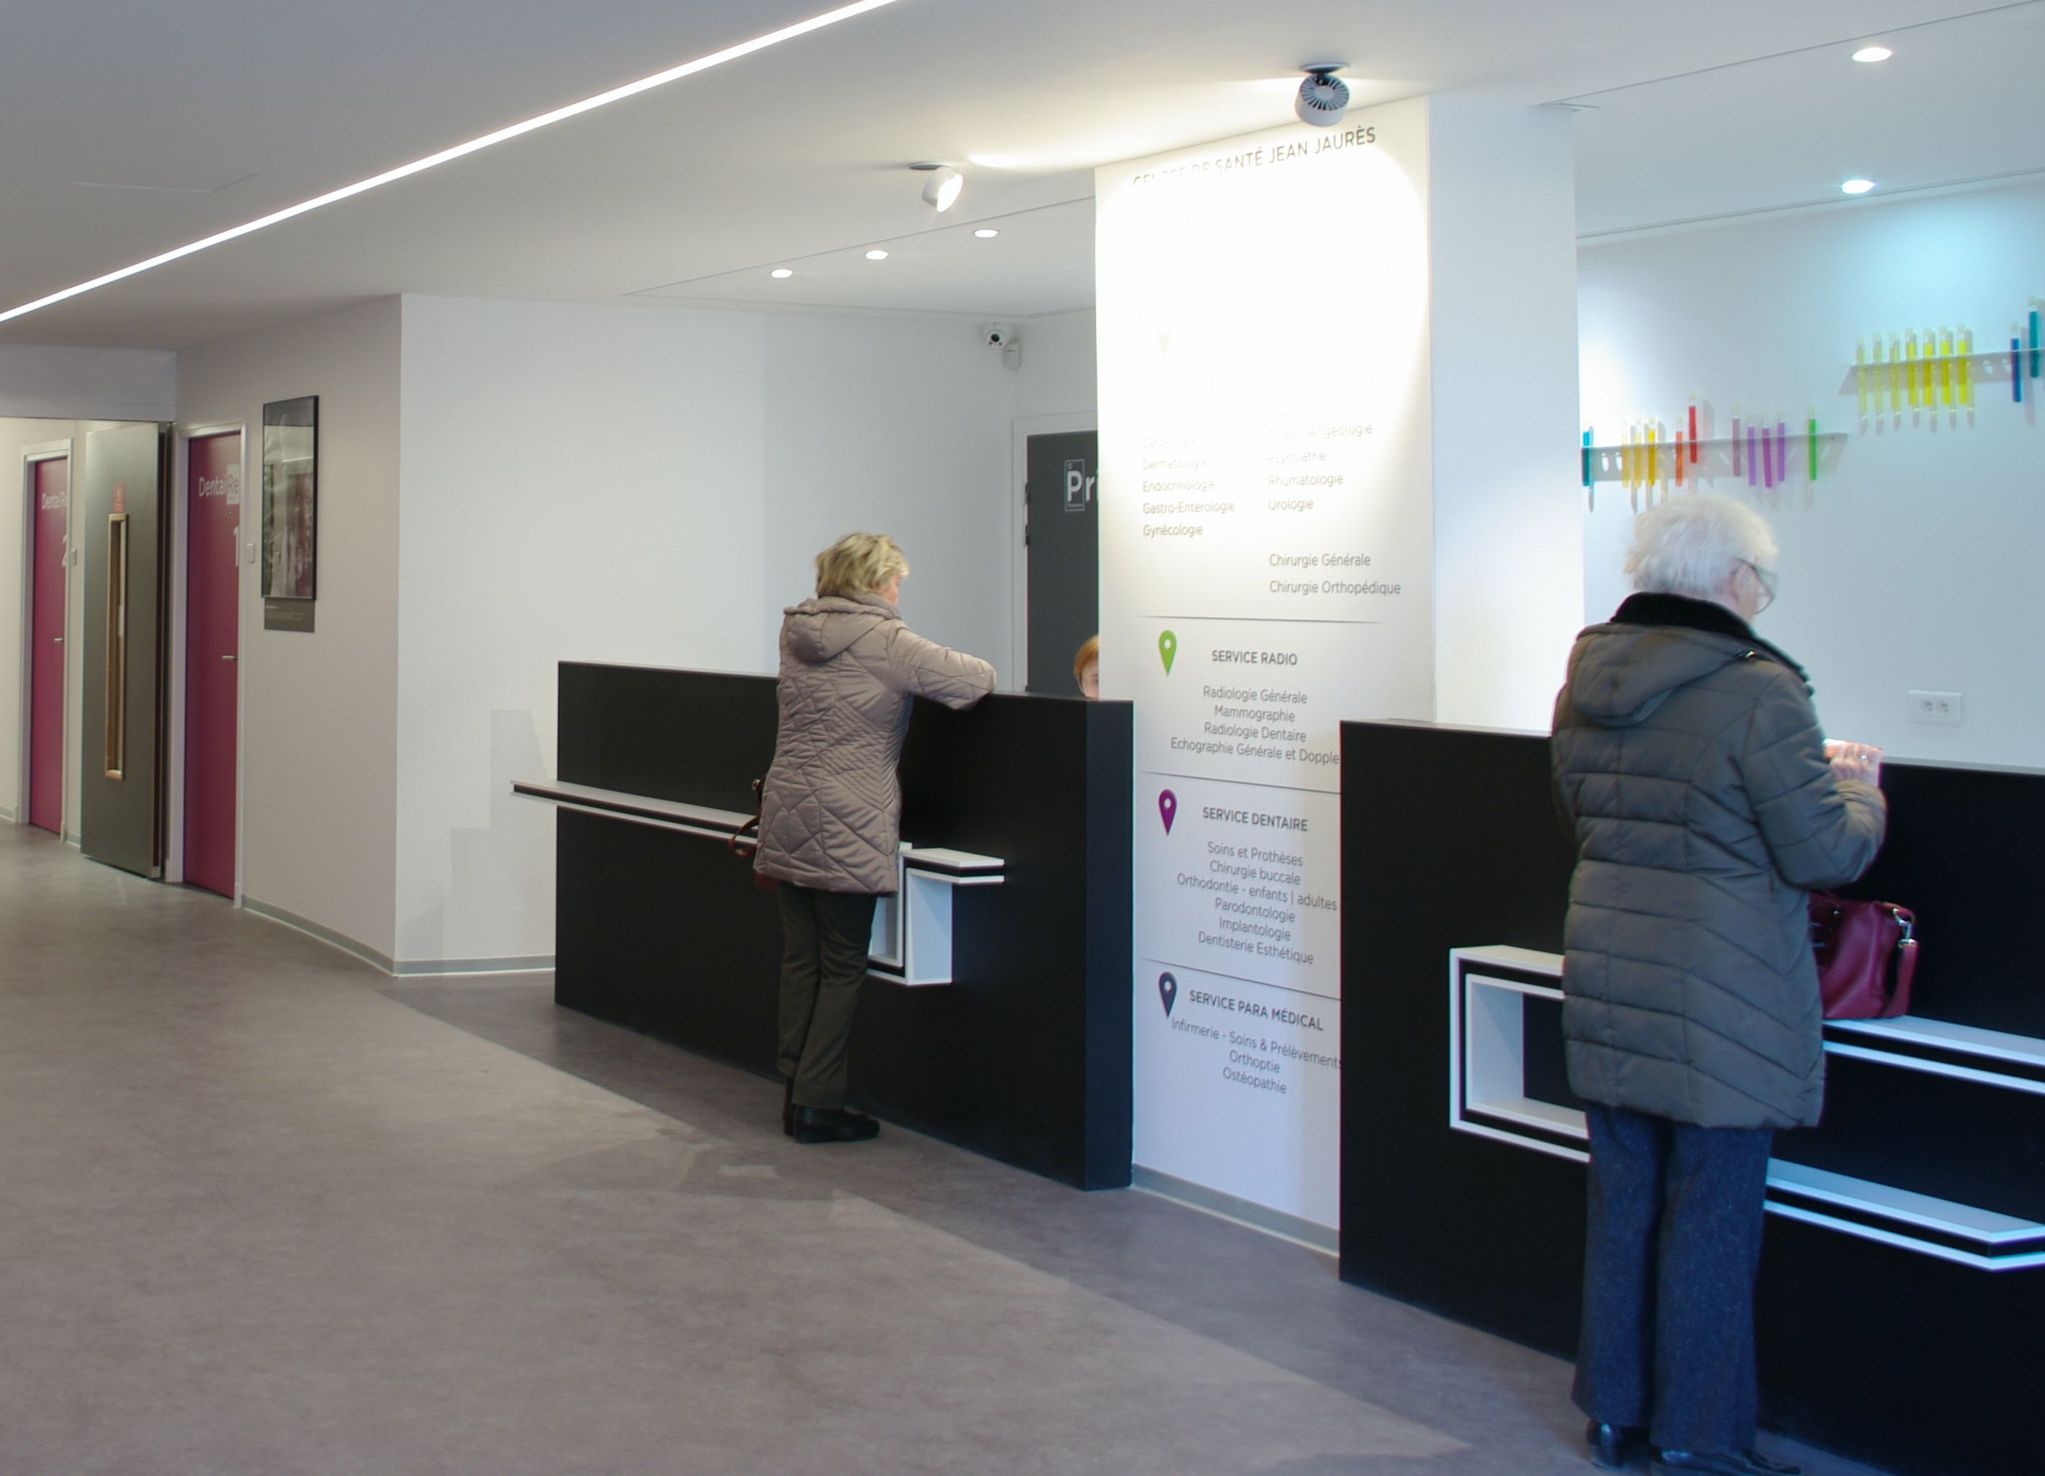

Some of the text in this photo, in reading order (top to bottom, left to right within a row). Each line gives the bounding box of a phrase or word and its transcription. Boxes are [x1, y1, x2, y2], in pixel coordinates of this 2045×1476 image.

[1215, 147, 1263, 173] SANTÉ
[1268, 140, 1308, 164] JEAN
[1314, 124, 1377, 154] JAURÈS
[1142, 480, 1216, 493] Endocrinologie
[1267, 474, 1345, 489] Rhumatologie
[1268, 498, 1315, 512] Urologie
[1142, 523, 1204, 538] Gynécologie
[1268, 552, 1372, 569] Chirurgie Générale
[1268, 580, 1402, 597] Chirurgie Orthopédique
[1211, 650, 1298, 666] SERVICE RADIO
[1203, 685, 1308, 704] Radiologie Générale
[1214, 704, 1296, 723] Mammographie
[1204, 721, 1307, 742] Radiologie Dentaire
[1170, 737, 1234, 754] Echographie
[1236, 742, 1283, 759] Générale
[1286, 749, 1297, 761] et
[1203, 807, 1309, 832] SERVICE DENTAIRE
[1207, 842, 1304, 867] Soins et Prothèses
[1210, 860, 1301, 885] Chirurgie buccale
[1177, 873, 1239, 895] Orthodontie
[1249, 886, 1288, 903] enfants
[1297, 894, 1338, 911] adultes
[1215, 897, 1296, 923] Parodontologie
[1219, 917, 1292, 941] Implantologie
[1198, 931, 1314, 966] Dentisterie Esthétique
[1189, 990, 1324, 1031] SERVICE PARA MÉDICAL
[1171, 1018, 1220, 1040] Infirmerie
[1229, 1031, 1257, 1049] Soins
[1260, 1038, 1268, 1052] &
[1229, 1050, 1281, 1074] Orthoptie
[1222, 1067, 1288, 1094] Ostéopathie
